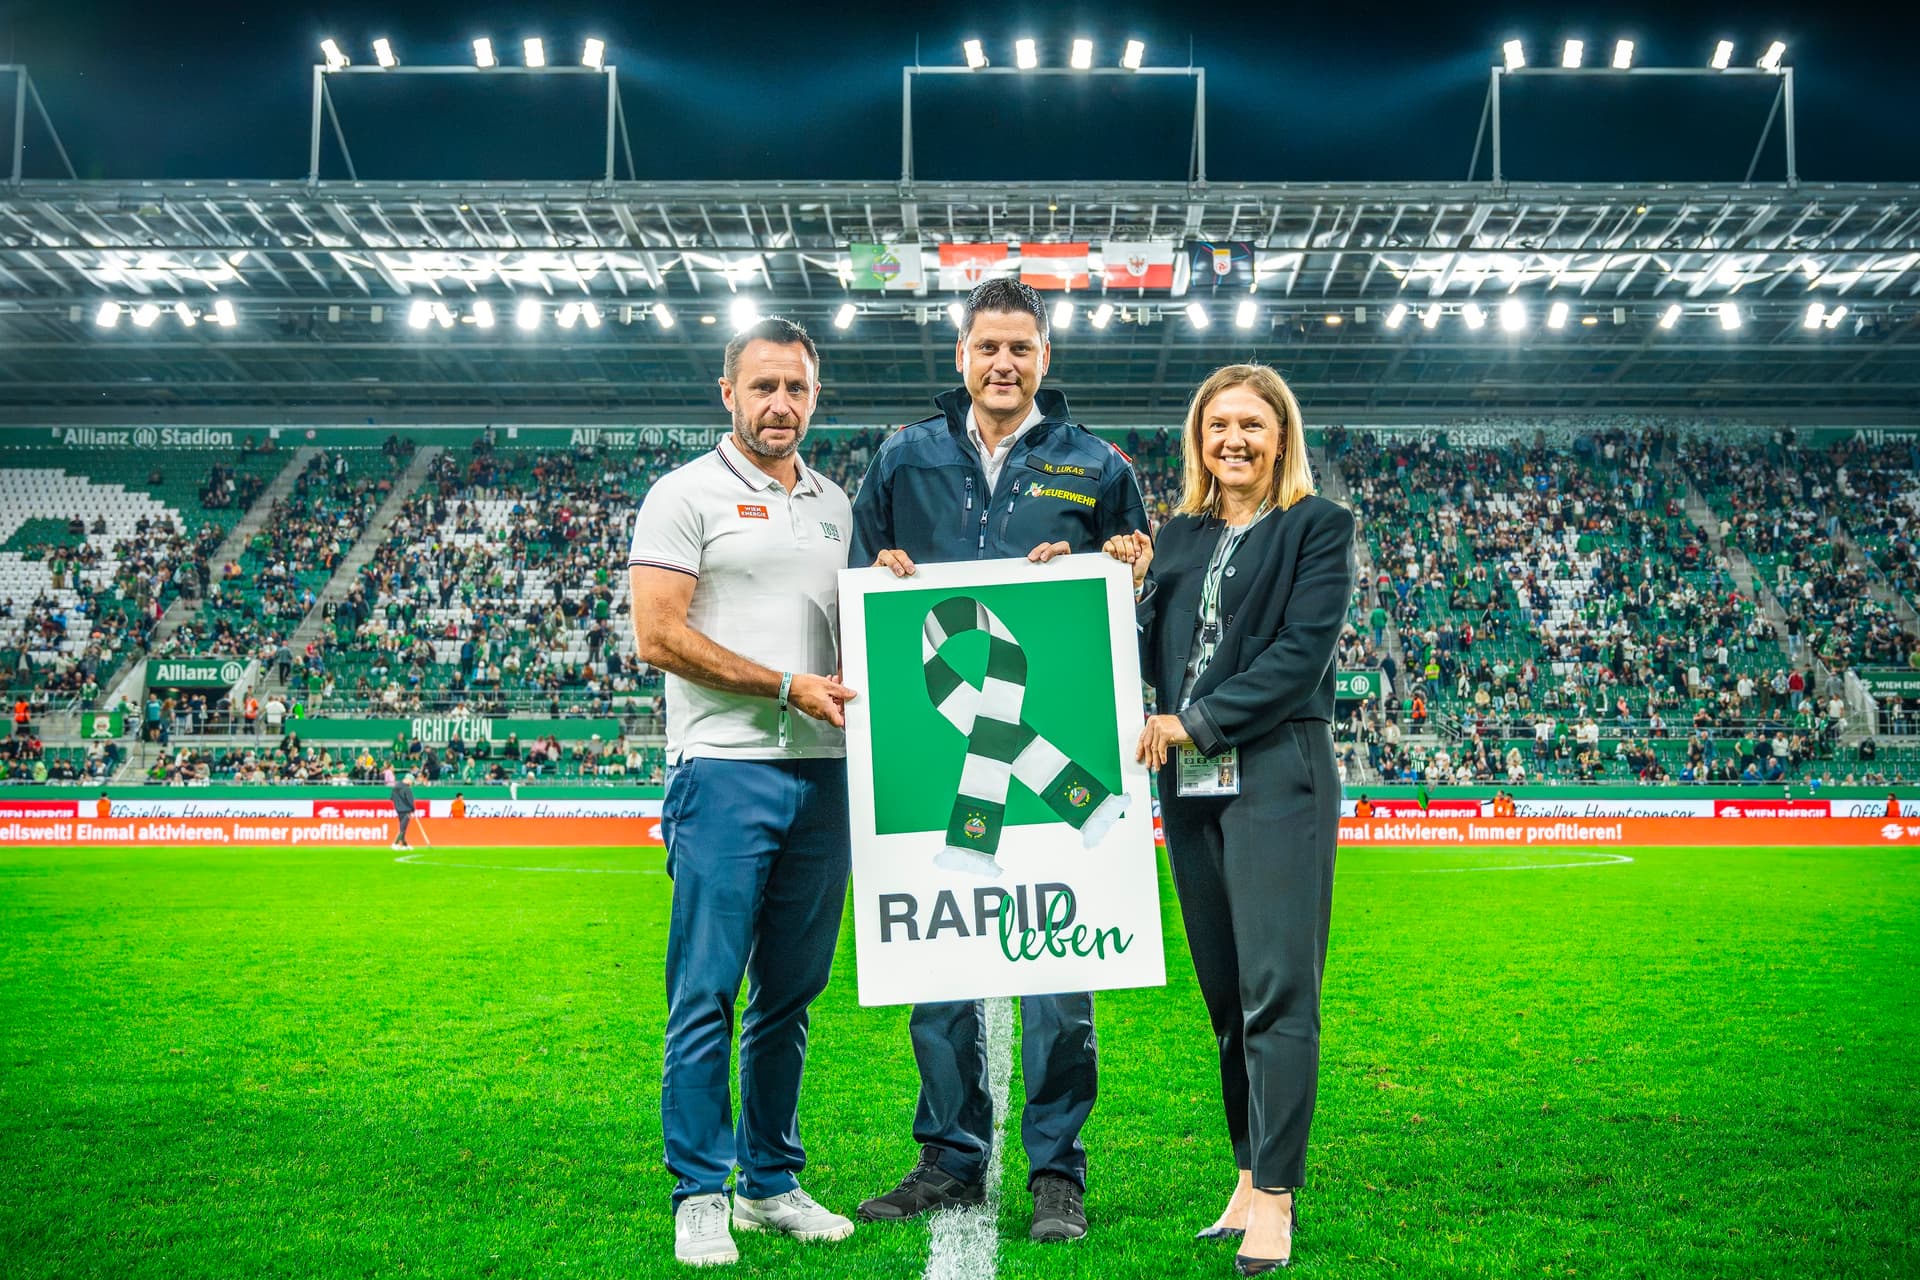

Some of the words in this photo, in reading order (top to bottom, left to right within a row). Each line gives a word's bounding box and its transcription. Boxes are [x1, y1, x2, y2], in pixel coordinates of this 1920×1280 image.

[64, 428, 129, 444] Allianz
[161, 428, 232, 444] Stadion
[1043, 464, 1054, 472] M.
[1056, 466, 1085, 475] LUKAS
[1040, 488, 1096, 508] FEUERWEHR
[156, 664, 218, 681] Allianz
[412, 718, 492, 742] ACHTZEHN
[77, 824, 135, 840] Einmal
[138, 824, 230, 843] aktivieren,
[233, 824, 289, 840] immer
[291, 824, 388, 844] profitieren!
[1374, 824, 1464, 843] aktivieren,
[1468, 823, 1523, 840] immer
[1526, 823, 1622, 844] profitieren!
[878, 882, 1077, 943] RAPID
[998, 890, 1134, 962] leben
